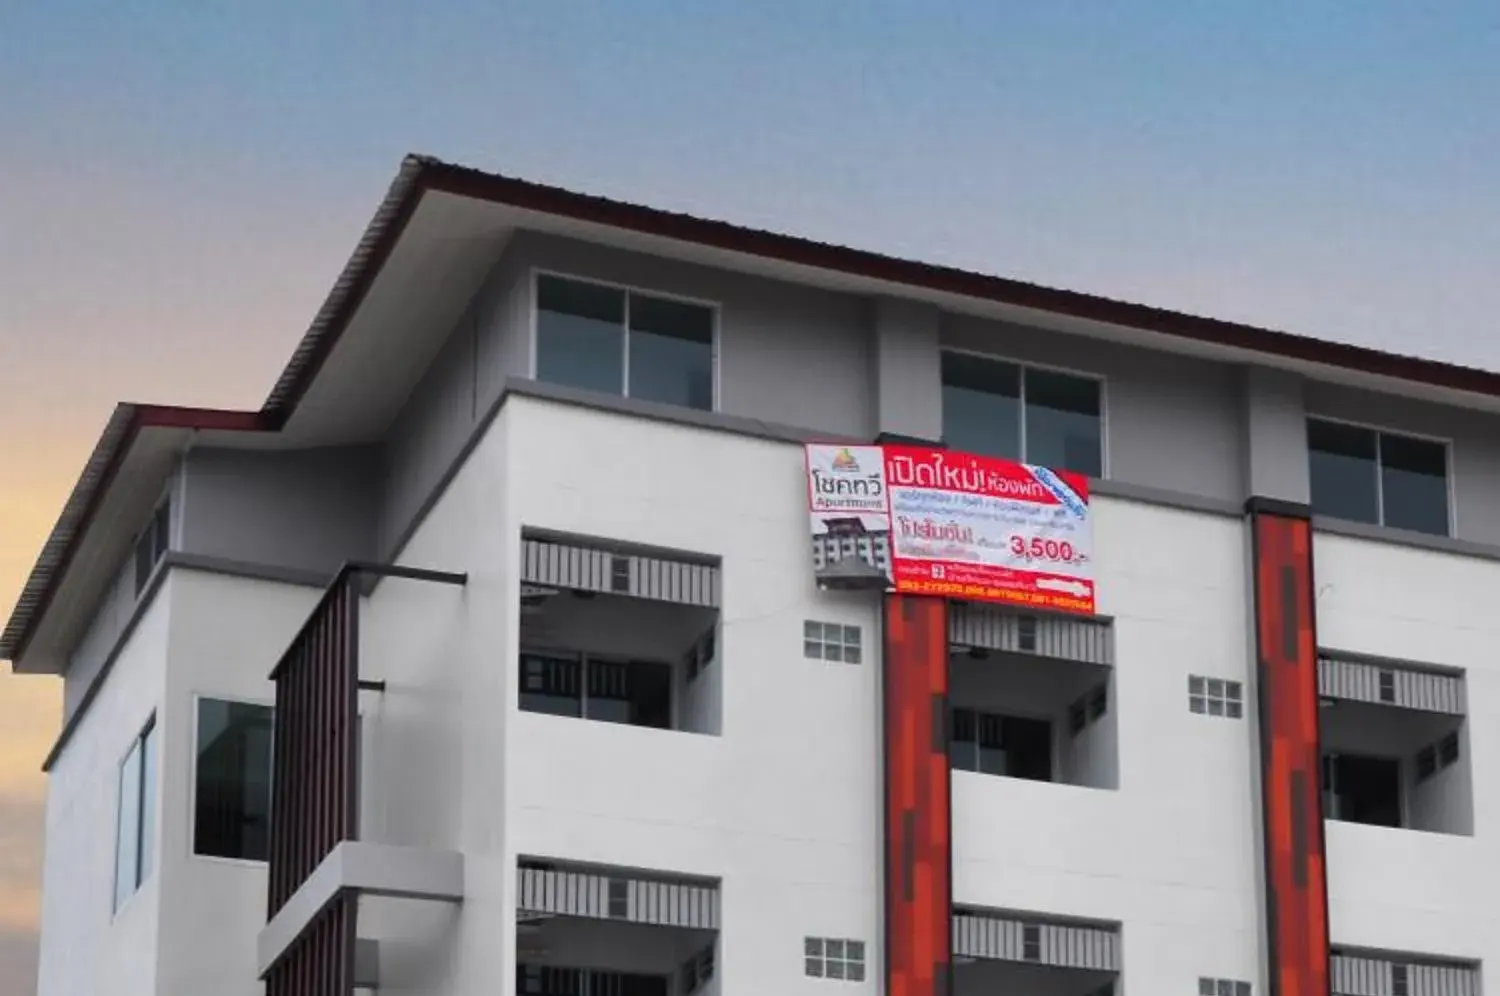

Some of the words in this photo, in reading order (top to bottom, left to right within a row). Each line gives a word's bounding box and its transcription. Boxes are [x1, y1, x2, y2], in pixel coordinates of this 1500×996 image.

[811, 467, 882, 497] โชคทวี
[887, 453, 985, 493] เปิดใหม่!
[987, 470, 1043, 497] ห้องพัก
